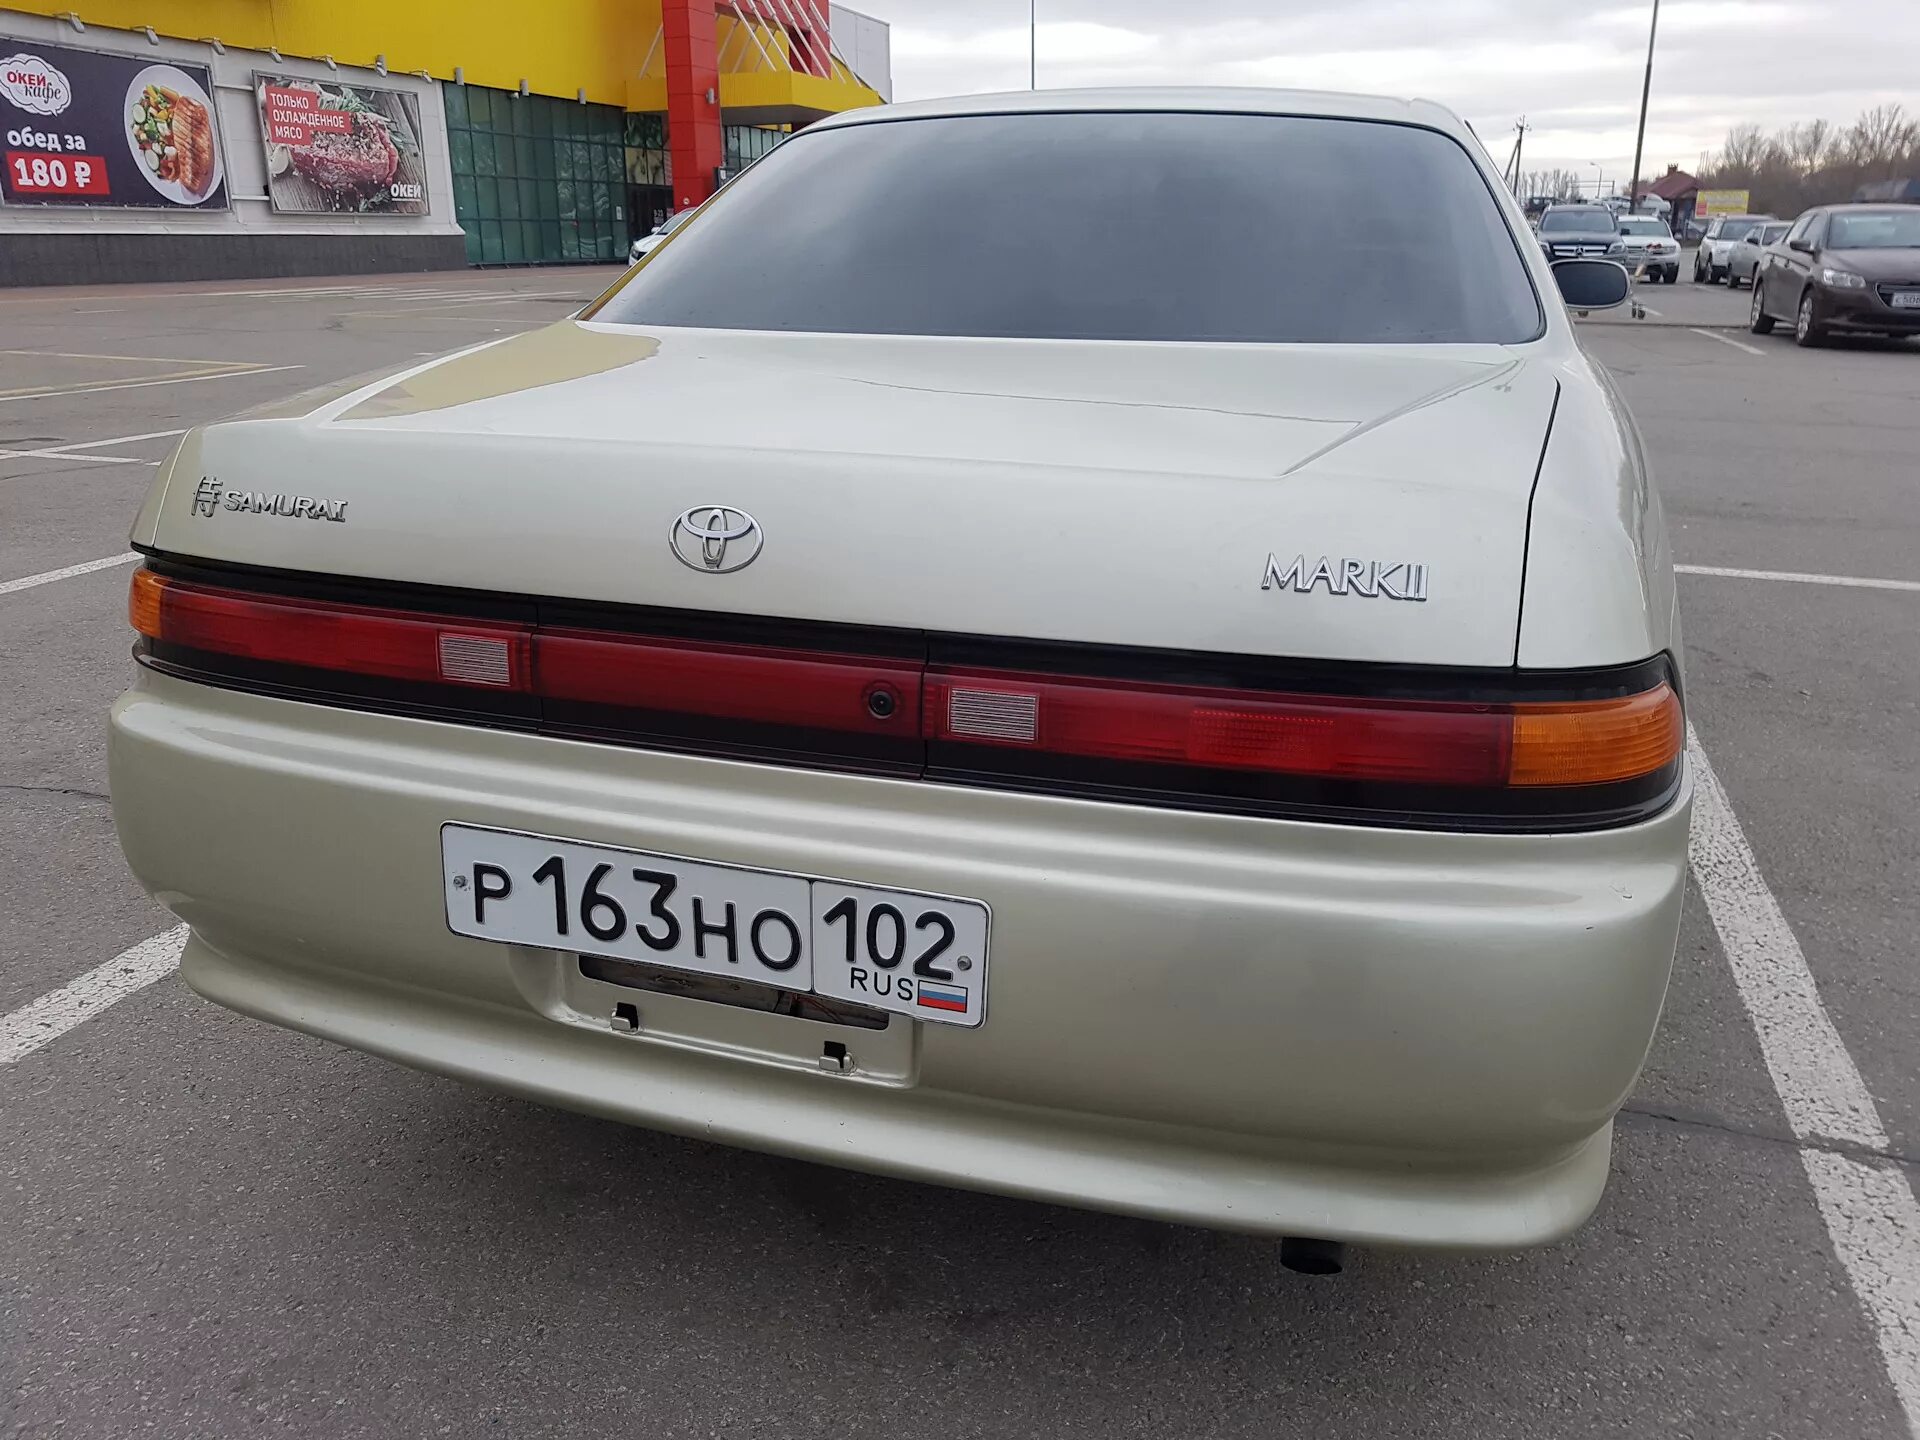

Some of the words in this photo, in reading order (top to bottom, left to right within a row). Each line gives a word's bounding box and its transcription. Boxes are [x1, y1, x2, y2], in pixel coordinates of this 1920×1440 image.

[24, 81, 62, 103] кафе
[270, 92, 309, 110] ТОЛЬКО
[7, 126, 62, 152] обед
[64, 133, 86, 151] за
[275, 125, 303, 140] МЯСО
[14, 157, 68, 188] 180
[223, 490, 348, 523] SAMURAI
[823, 896, 955, 981] 102
[849, 966, 915, 1002] RUS
